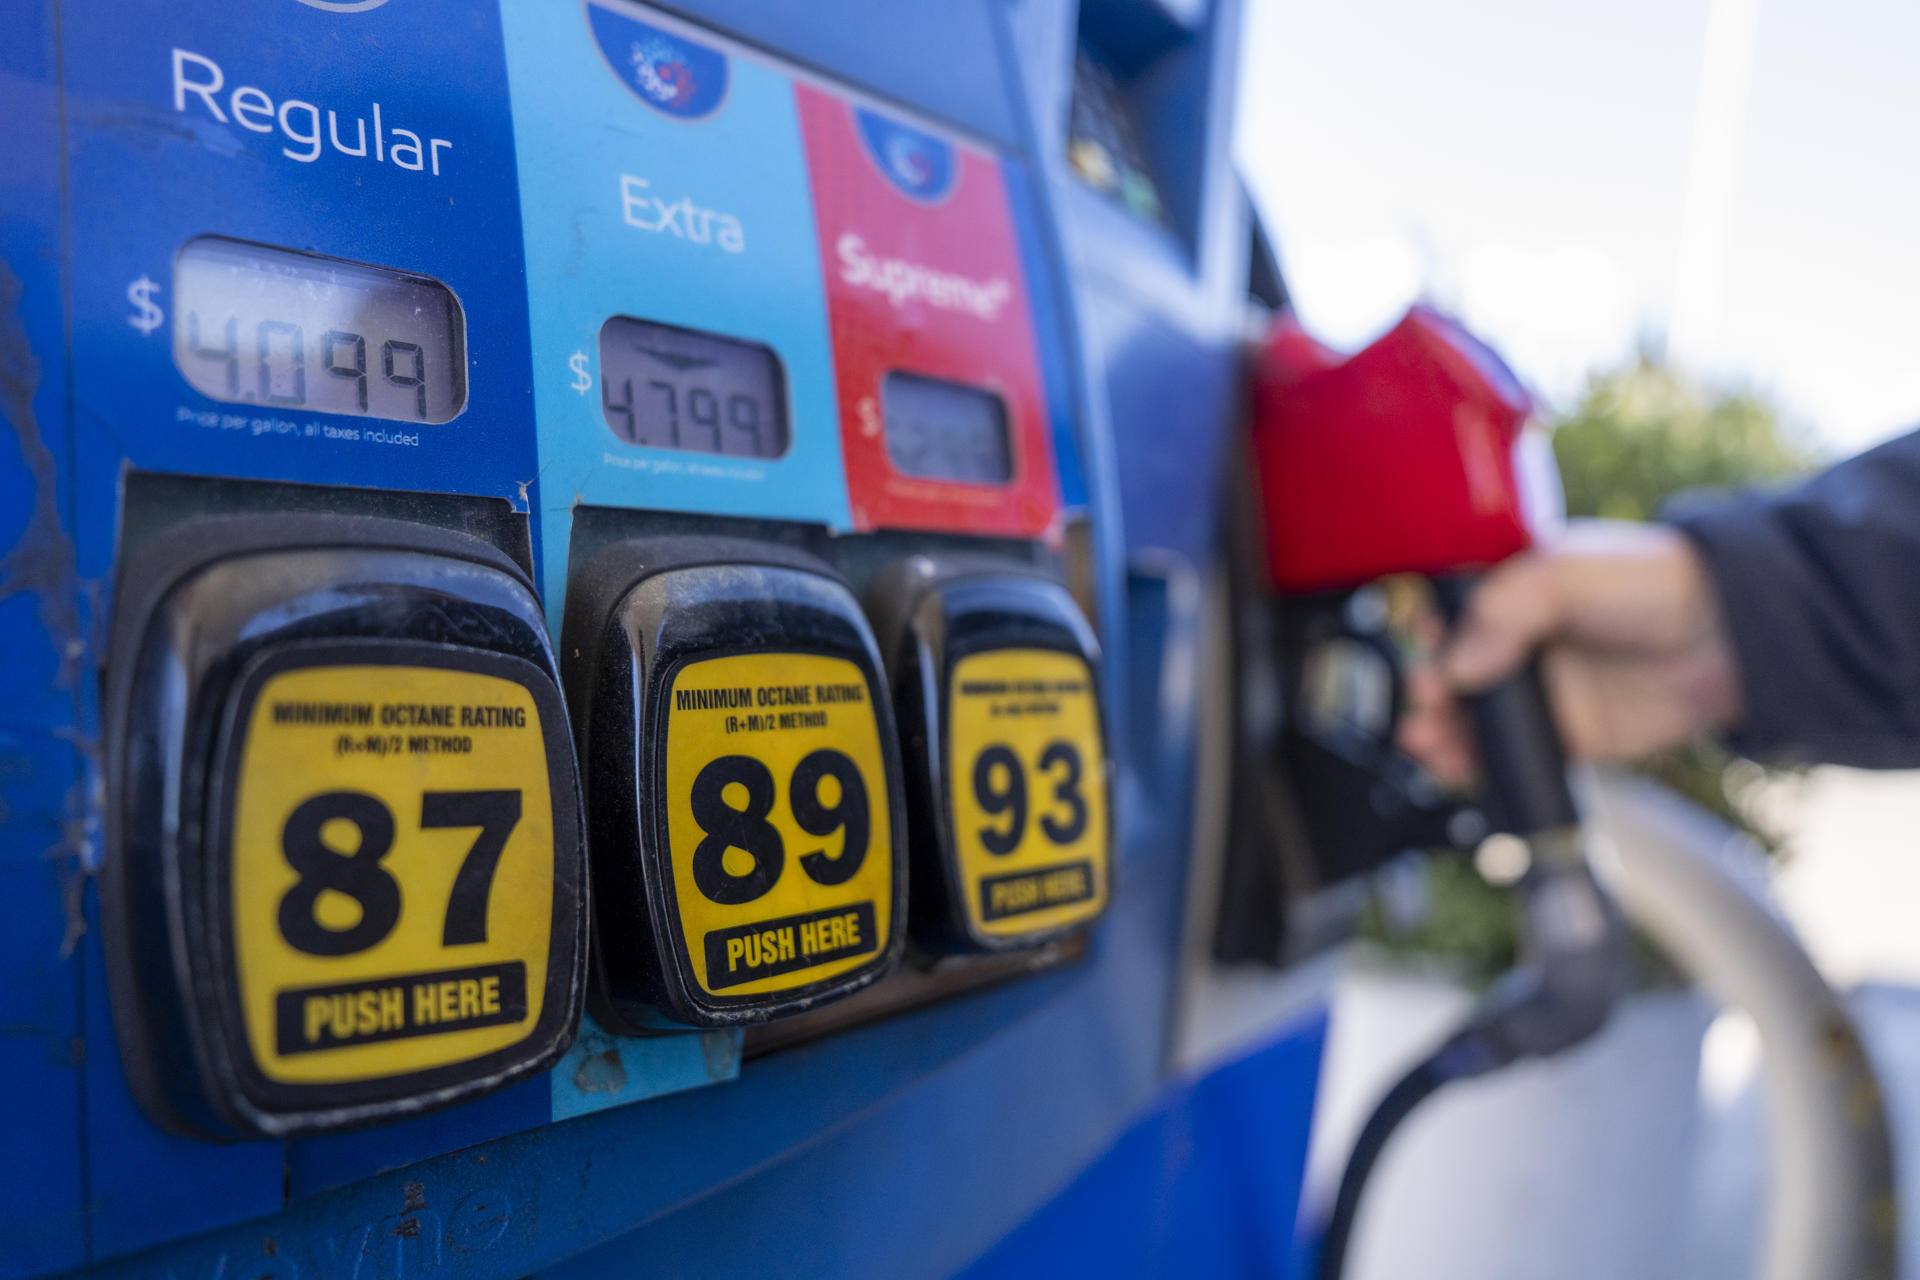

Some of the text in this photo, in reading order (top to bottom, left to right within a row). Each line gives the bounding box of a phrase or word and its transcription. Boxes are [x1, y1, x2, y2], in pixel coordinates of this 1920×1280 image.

[171, 47, 453, 177] Regular
[620, 174, 745, 254] Extra
[127, 276, 427, 420] $ 4.099
[176, 406, 219, 428] Price
[220, 413, 248, 431] per
[305, 422, 321, 438] all
[323, 424, 361, 442] taxes
[362, 427, 420, 448] included
[568, 350, 762, 457] $ 4.799
[273, 703, 527, 729] MINIMUM OCTANE RATING
[674, 683, 863, 711] MINIMUM OCTANE RATING
[725, 710, 828, 734] (R+M)/2 METHOD
[408, 735, 473, 755] METHOD
[690, 747, 872, 906] 89
[972, 740, 1088, 857] 93
[274, 787, 523, 958] 87
[726, 912, 862, 973] PUSH HERE
[303, 975, 501, 1043] PUSH HERE
